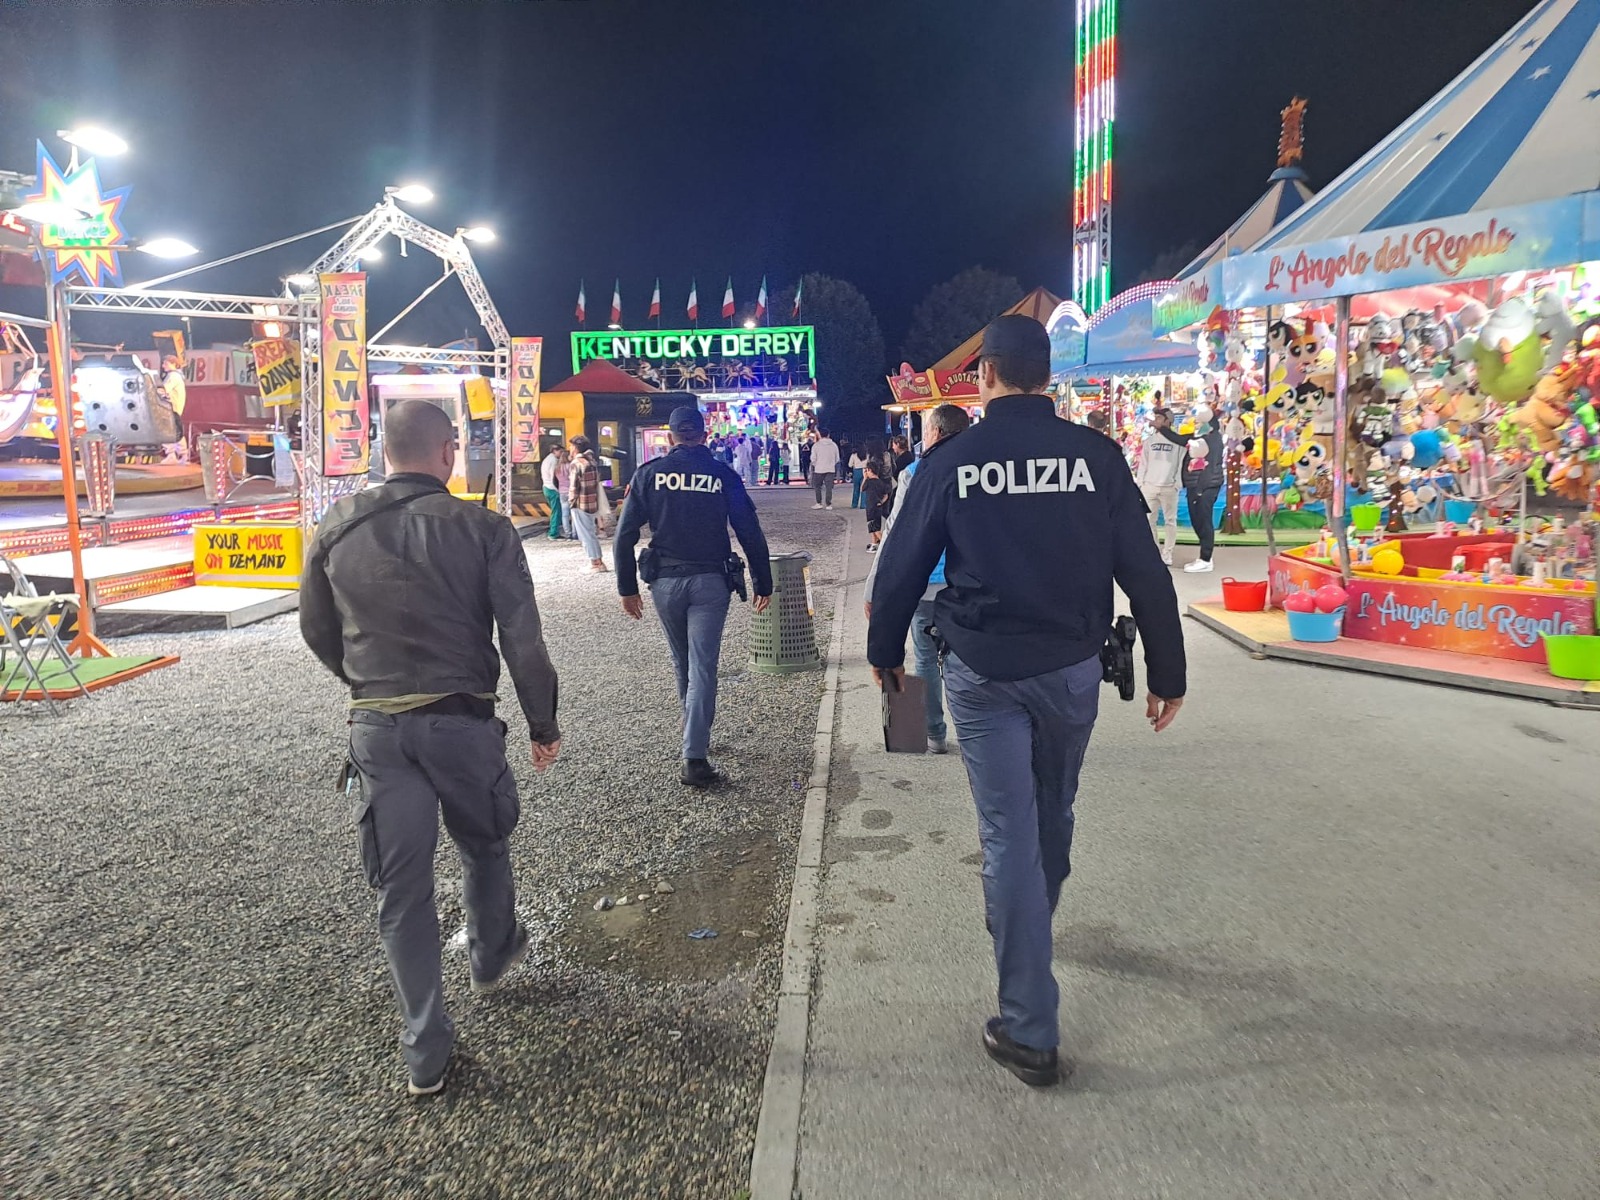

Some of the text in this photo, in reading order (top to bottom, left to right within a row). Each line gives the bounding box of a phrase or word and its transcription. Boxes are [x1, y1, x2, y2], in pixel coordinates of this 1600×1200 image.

[1374, 233, 1411, 273] del
[1414, 217, 1517, 277] Regalo
[580, 333, 805, 360] KENTUCKY DERBY
[948, 373, 971, 386] RUOTA
[654, 472, 723, 494] POLIZIA
[957, 458, 1096, 499] POLIZIA
[206, 533, 284, 551] YOUR MUSIC
[205, 553, 287, 570] ON DEMAND
[1454, 602, 1487, 631] del
[1488, 604, 1577, 648] Regalo
